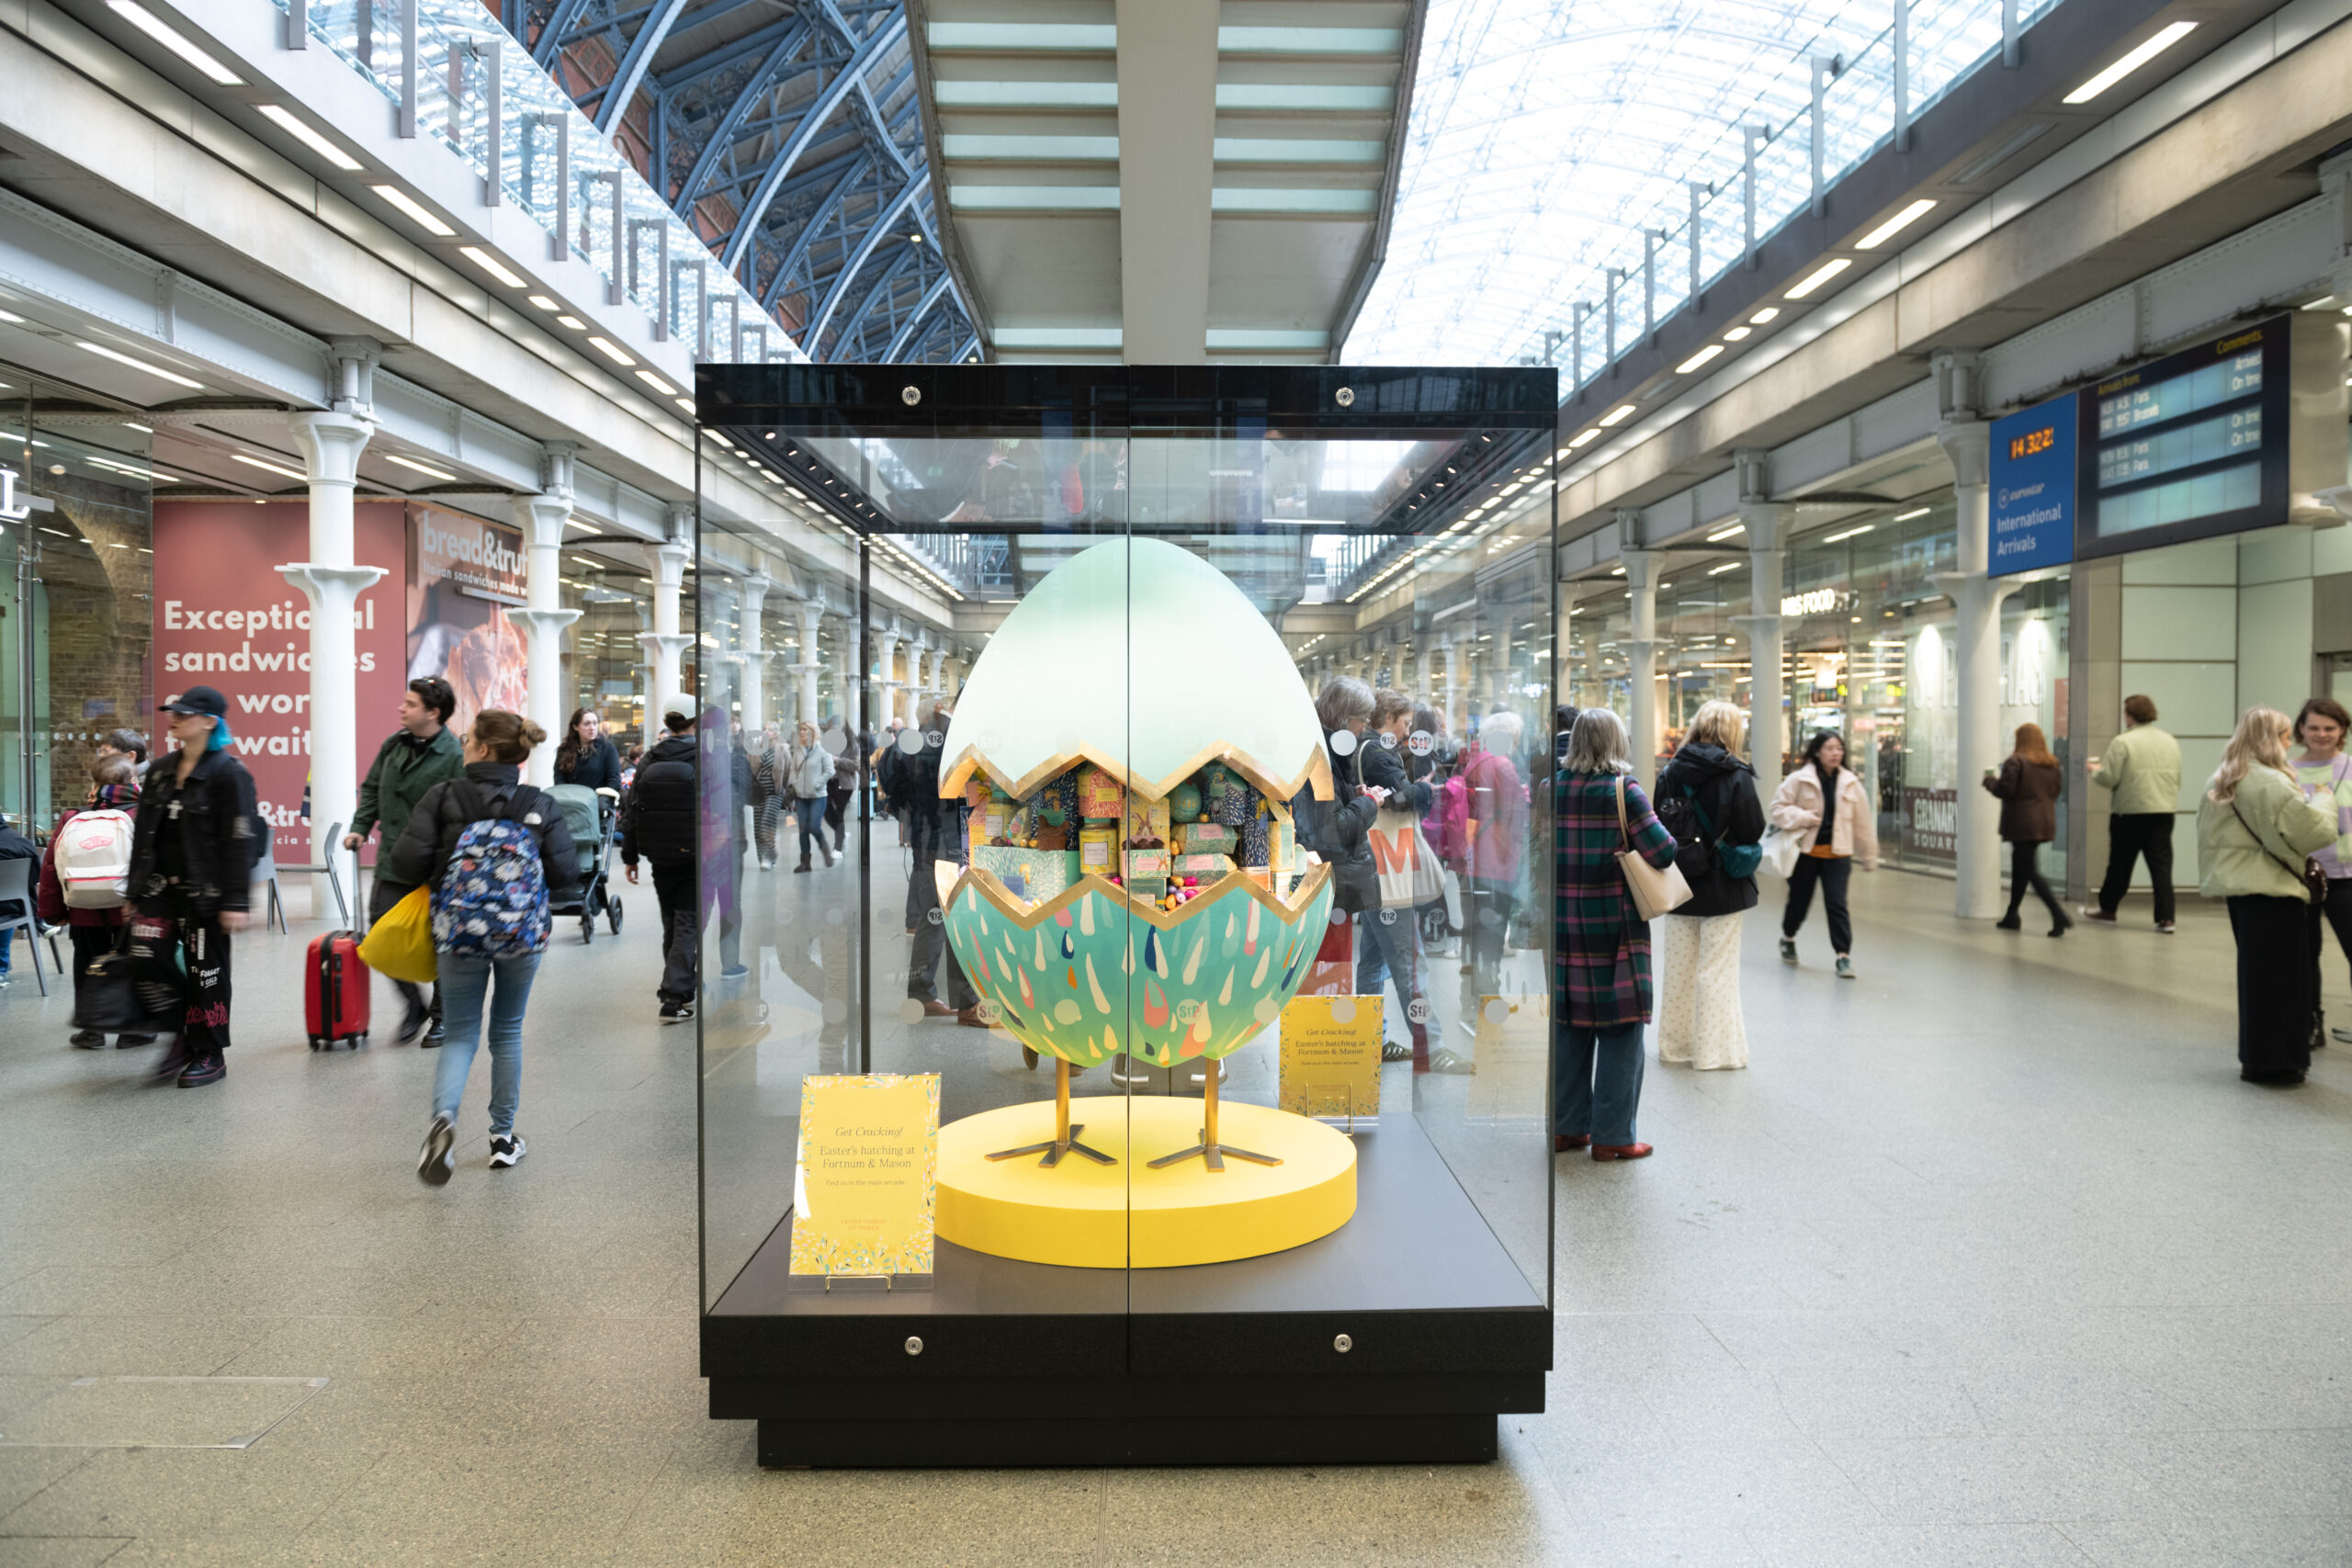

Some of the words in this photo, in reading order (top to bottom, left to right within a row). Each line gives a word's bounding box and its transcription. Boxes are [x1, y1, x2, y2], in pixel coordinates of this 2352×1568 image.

[1996, 503, 2062, 534] International
[424, 510, 528, 577] bread&truf
[1996, 535, 2036, 557] Arrivals
[424, 559, 452, 579] Italian
[454, 570, 499, 589] sandwiches
[500, 581, 519, 595] made
[1804, 588, 1836, 614] FOOD
[164, 599, 374, 638] Exceptiol
[164, 641, 376, 672] sandwics
[236, 694, 311, 714] wor
[835, 1127, 852, 1137] Get
[855, 1126, 903, 1139] Cracking!
[822, 1158, 865, 1168] Fortnum
[868, 1158, 876, 1168] &
[879, 1158, 911, 1168] Mason
[861, 1145, 903, 1156] hatching
[906, 1146, 916, 1155] at
